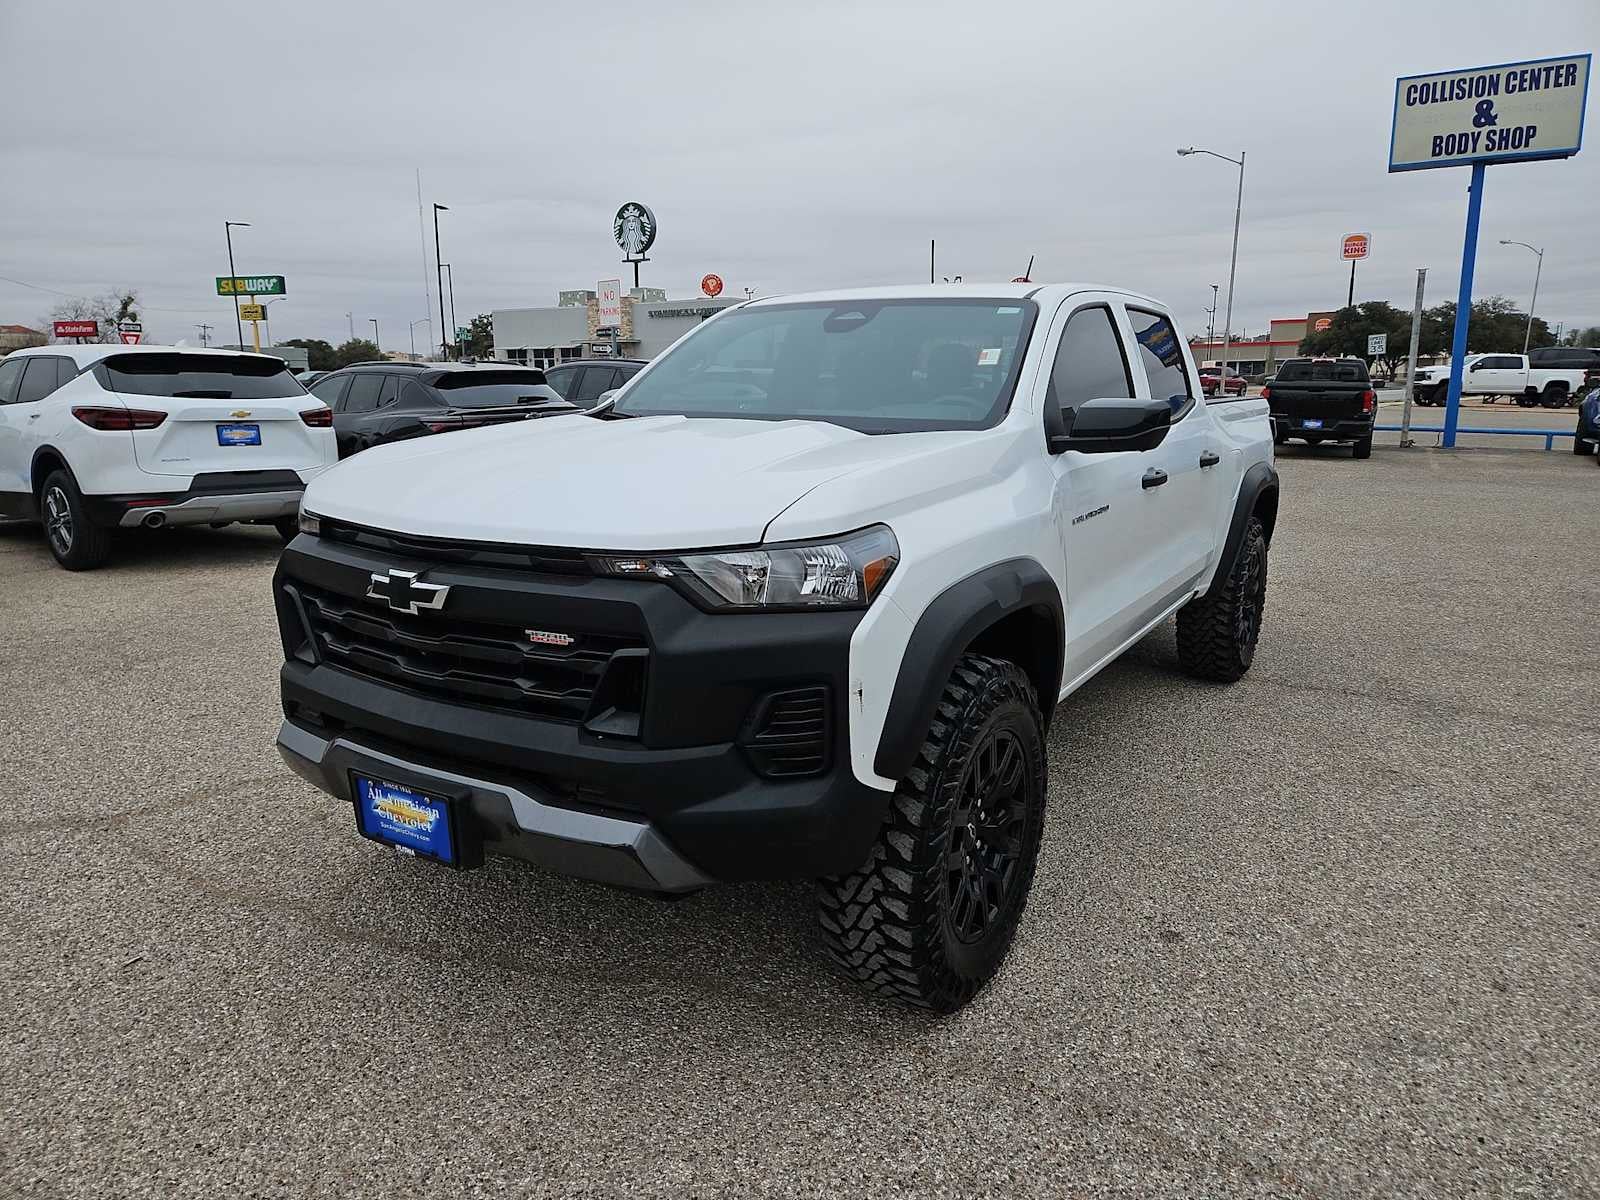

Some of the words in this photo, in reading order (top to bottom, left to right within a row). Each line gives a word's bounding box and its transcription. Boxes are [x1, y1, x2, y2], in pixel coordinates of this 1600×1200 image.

[1406, 73, 1500, 107] COLLISION
[1505, 63, 1578, 95] CENTER
[1472, 99, 1498, 128] &
[1431, 130, 1483, 157] BODY
[1484, 125, 1538, 153] SHOP
[219, 278, 278, 292] SUBWAY
[603, 290, 615, 301] NO
[600, 306, 620, 317] PARKING
[368, 787, 382, 800] All
[387, 792, 440, 819] American
[377, 805, 433, 832] Chevrolet
